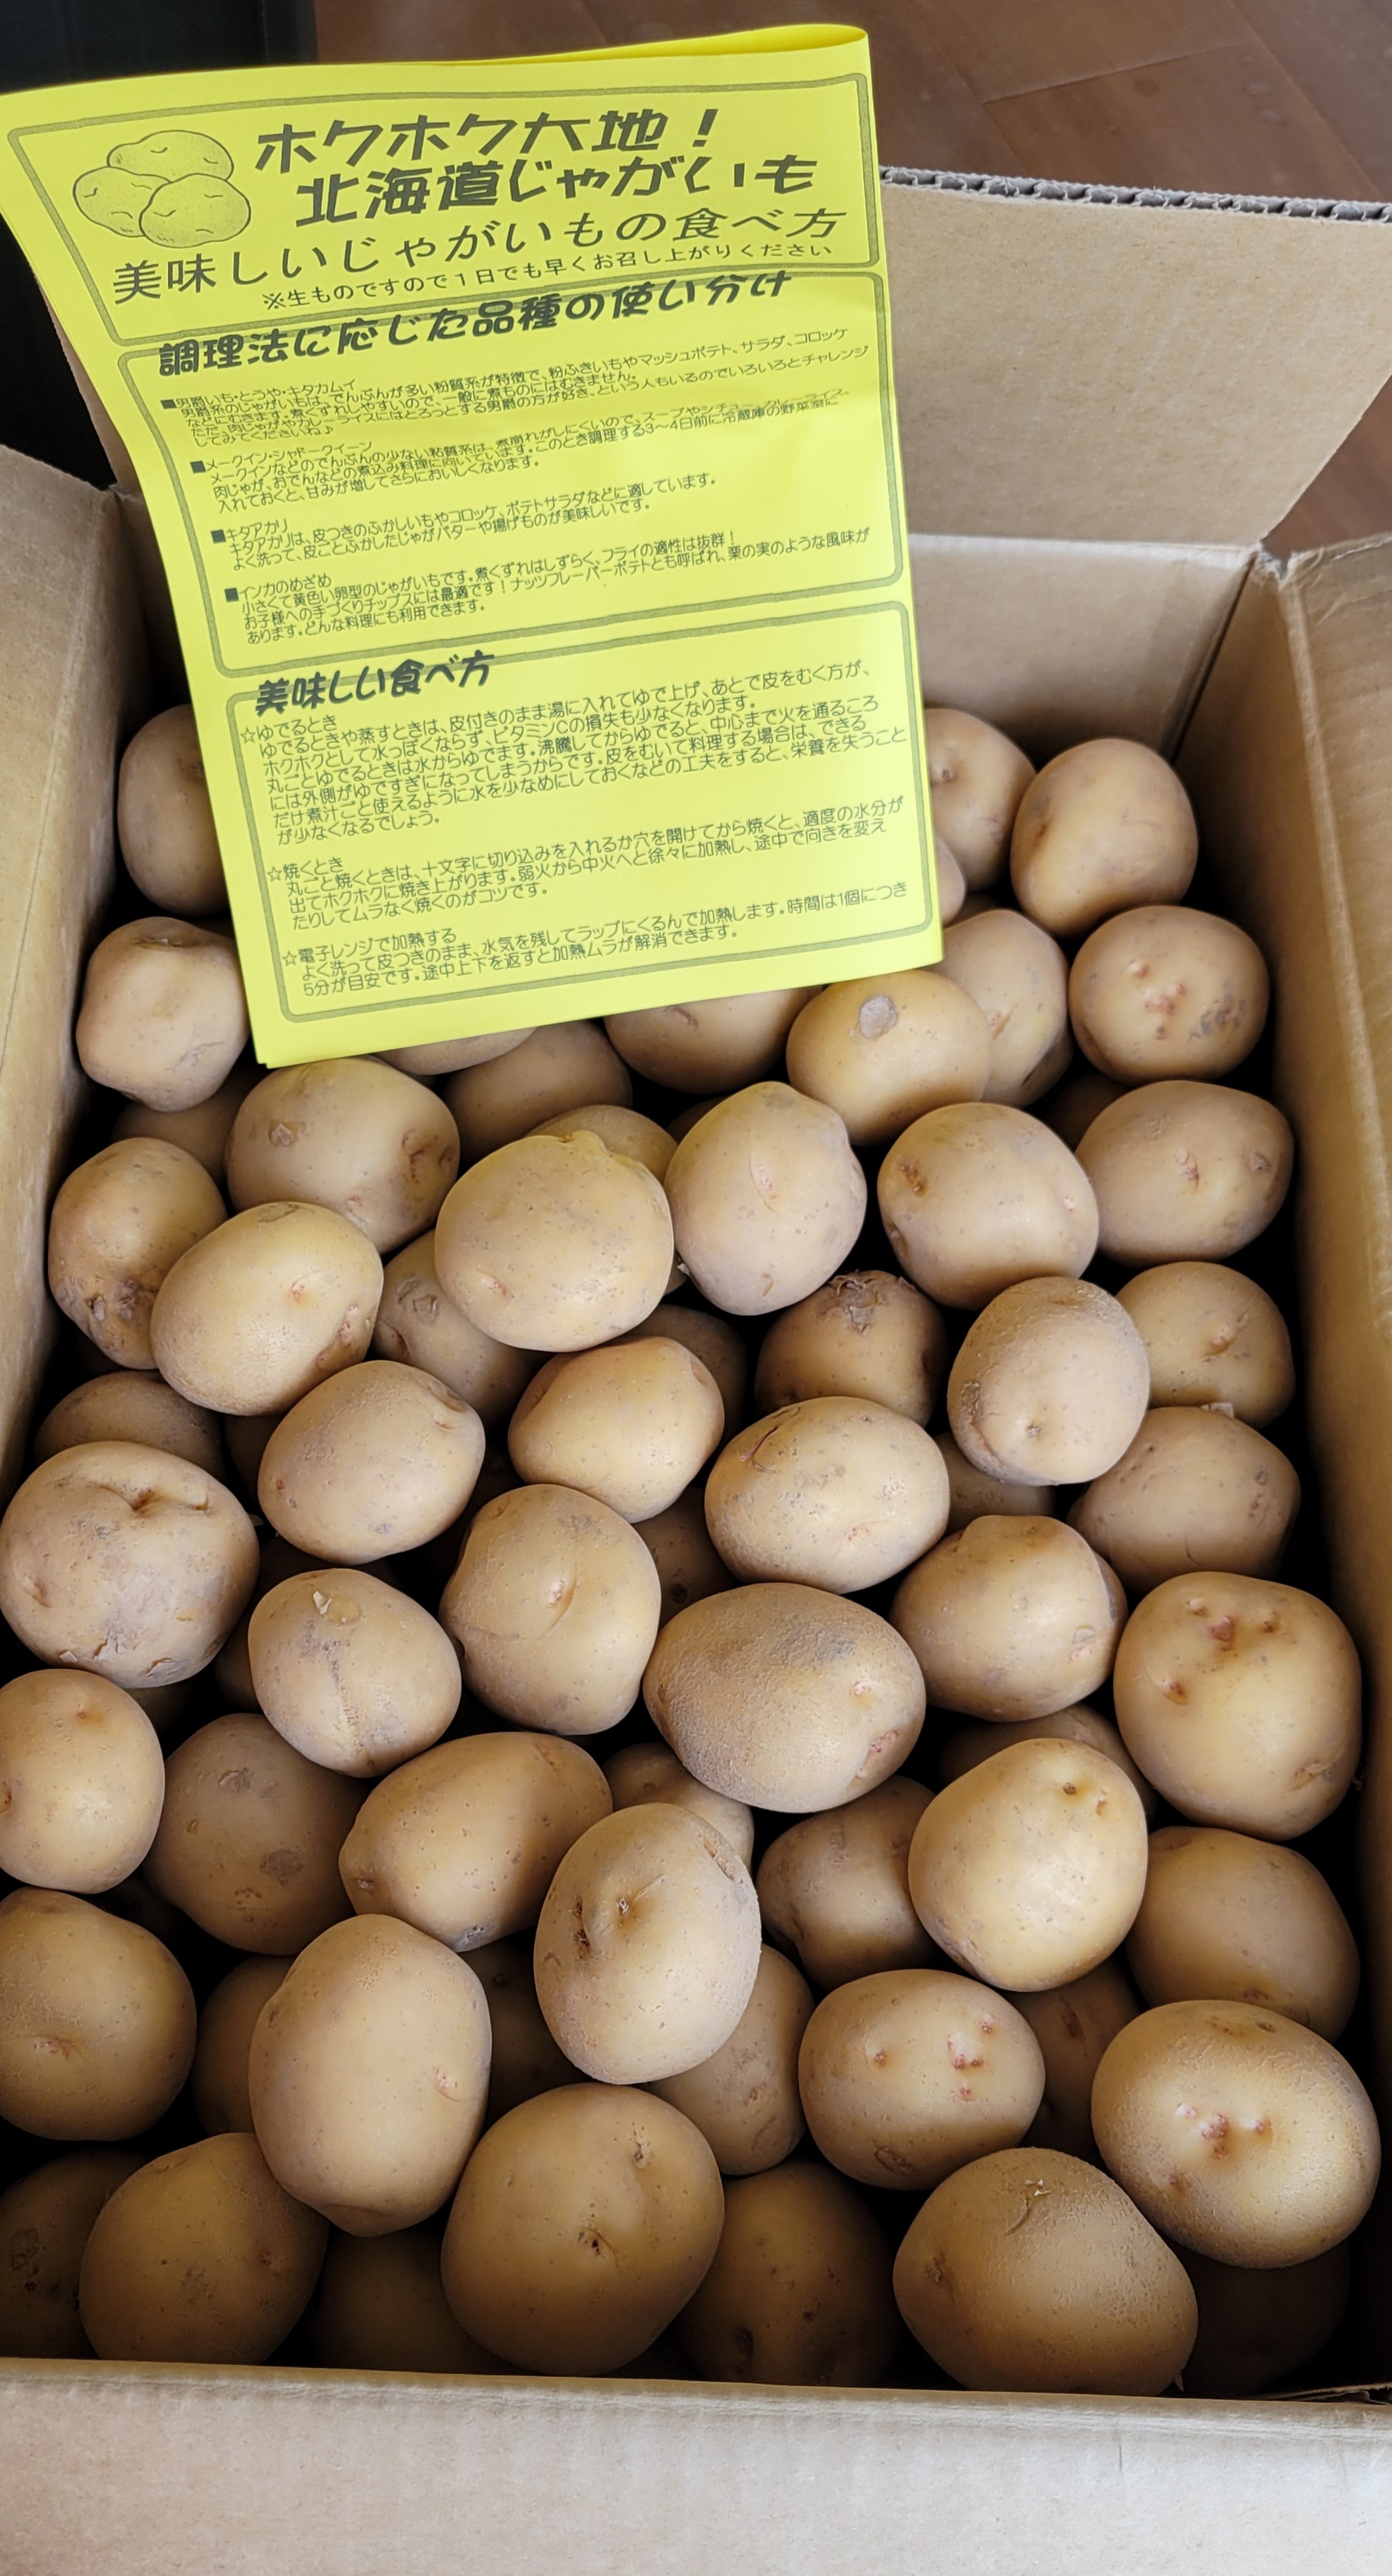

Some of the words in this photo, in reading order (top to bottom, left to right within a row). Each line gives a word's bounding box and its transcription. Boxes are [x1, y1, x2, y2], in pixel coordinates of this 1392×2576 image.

[296, 154, 818, 228] 北海道じゃがいも
[113, 207, 847, 305] 美味しいじゃがいもの食べ方
[159, 269, 792, 376] 調理法に応じた品種の使い分け
[225, 518, 288, 543] キタアカリ
[238, 573, 332, 598] インカのめざめ
[255, 649, 495, 717] 美味しい食べ方
[257, 715, 337, 741] ゆでるとき
[277, 810, 439, 846] が少なくなるでしょう。
[283, 856, 343, 881] 焼くとき
[298, 928, 456, 964] 電子レンジで加熱する
